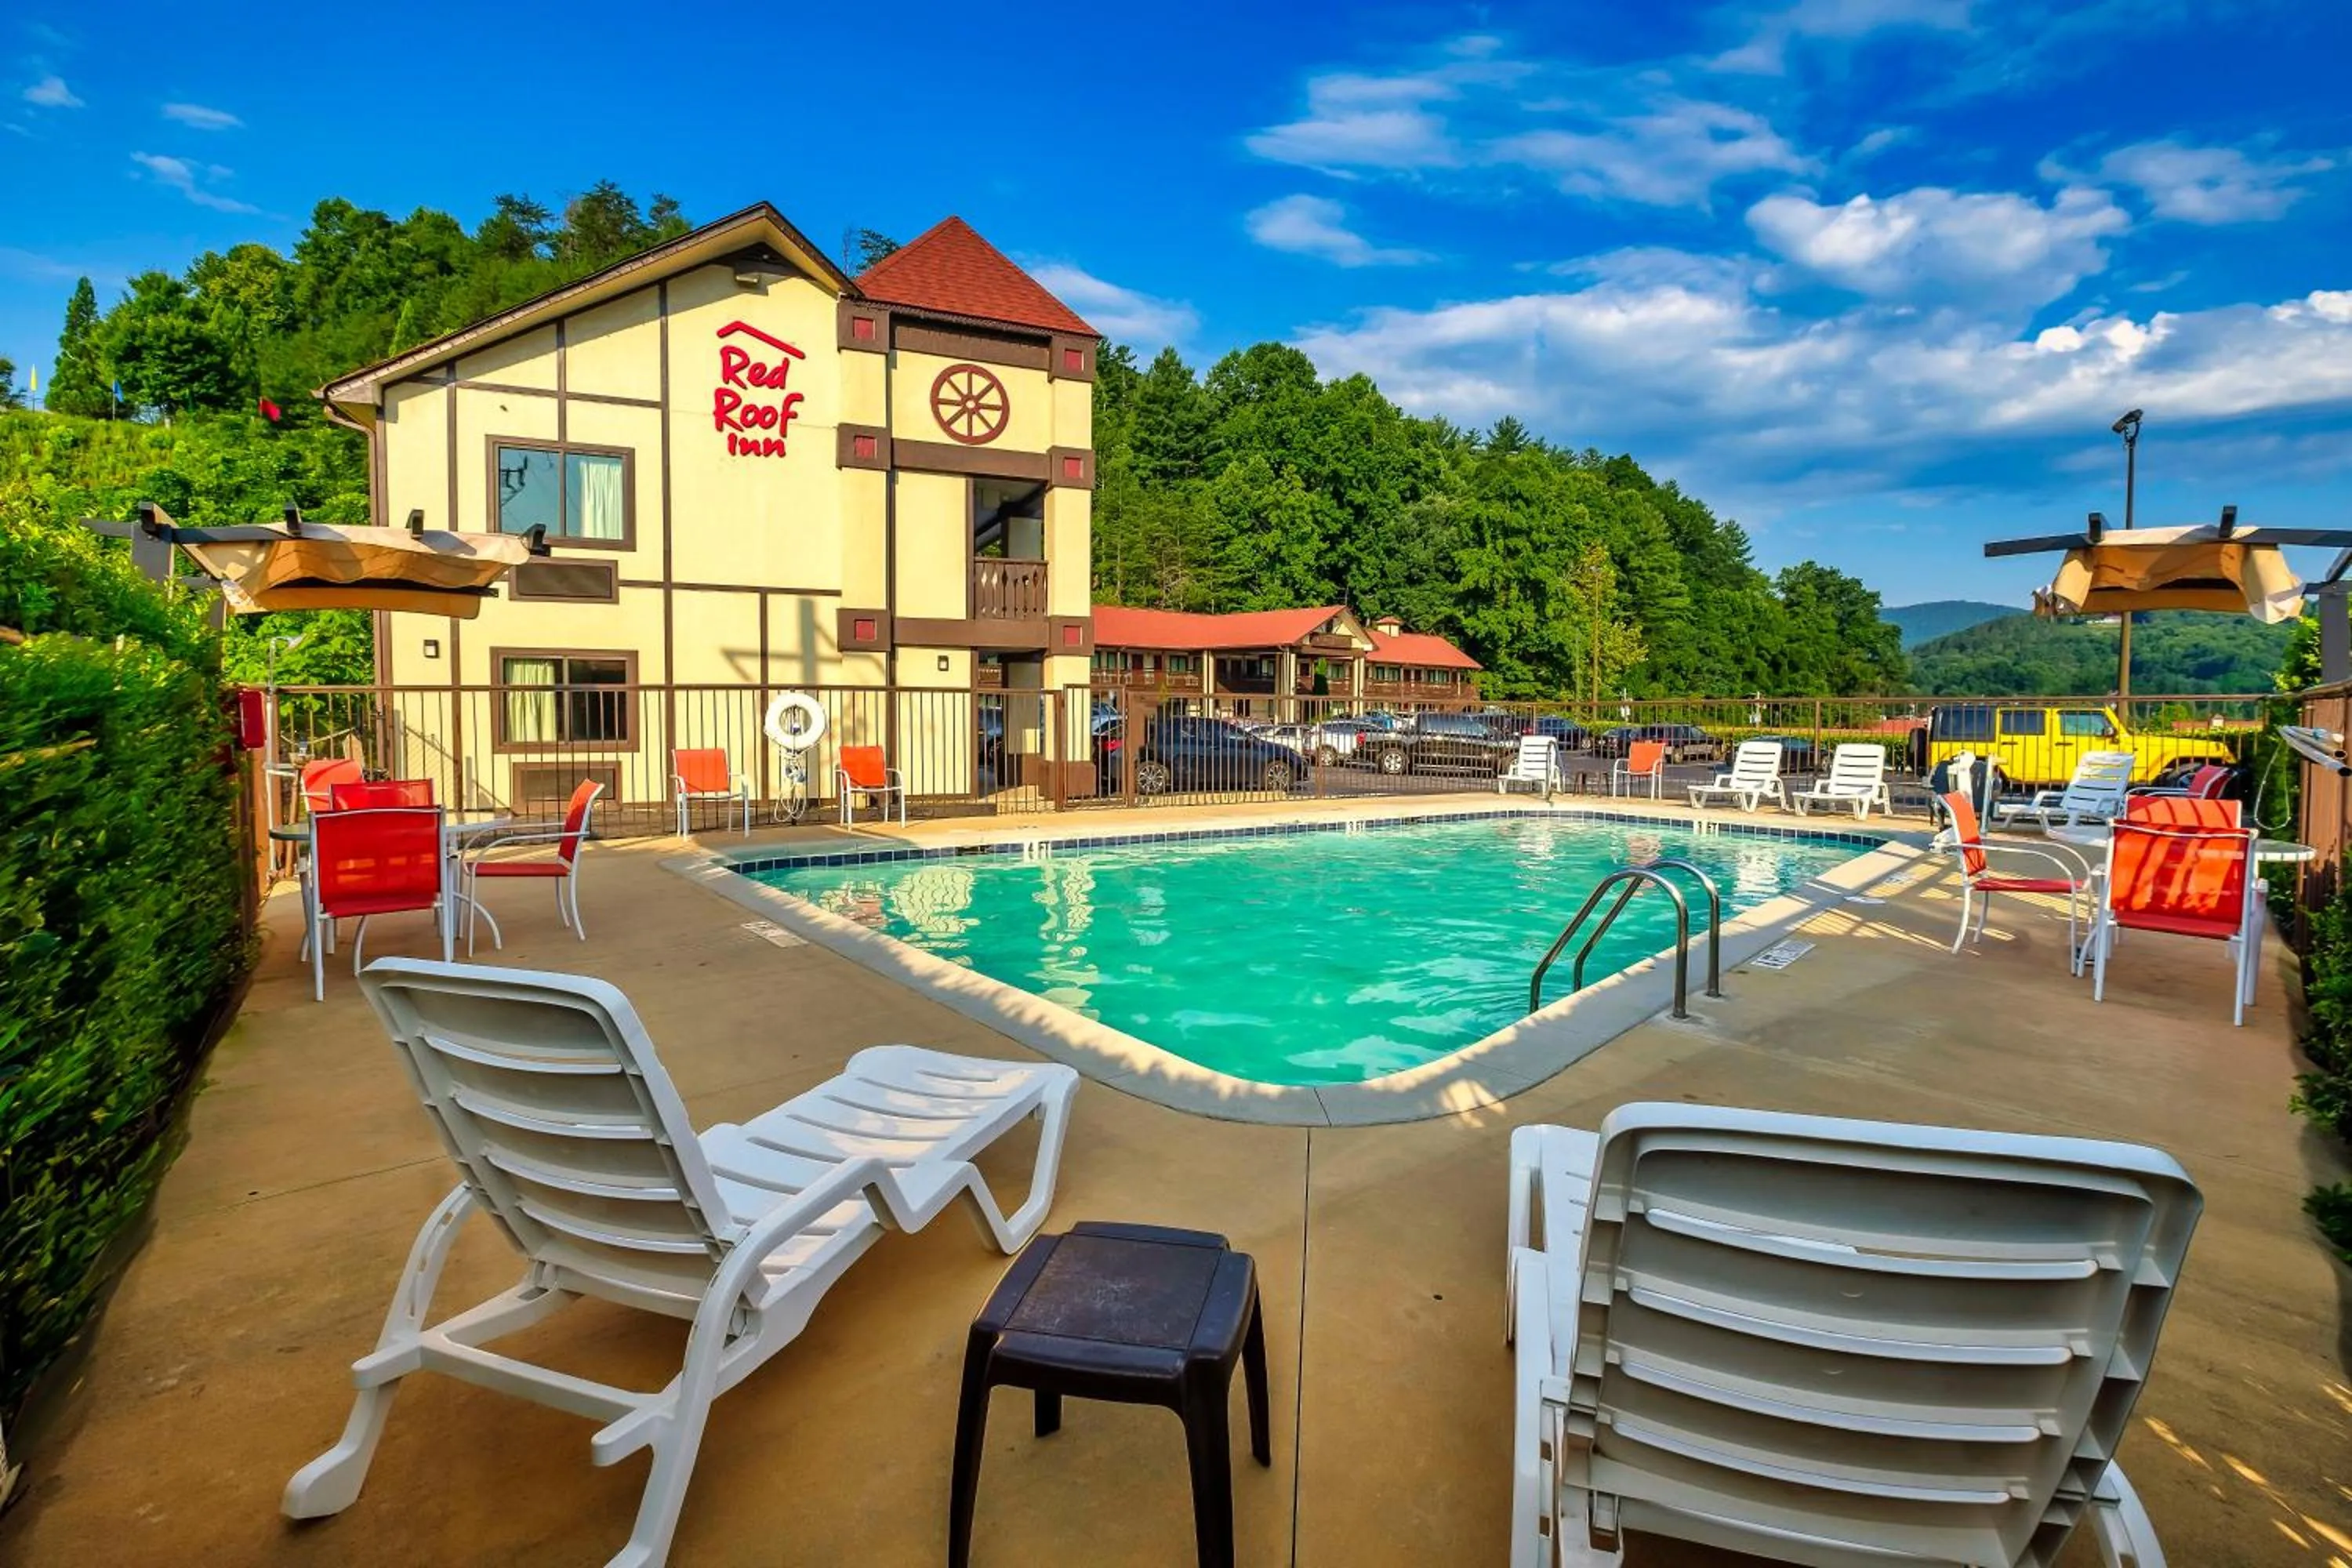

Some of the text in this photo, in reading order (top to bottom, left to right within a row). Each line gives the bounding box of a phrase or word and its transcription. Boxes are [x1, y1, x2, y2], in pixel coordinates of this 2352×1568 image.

[720, 345, 789, 390] Red
[713, 387, 804, 437] Roof
[728, 433, 786, 458] Inn
